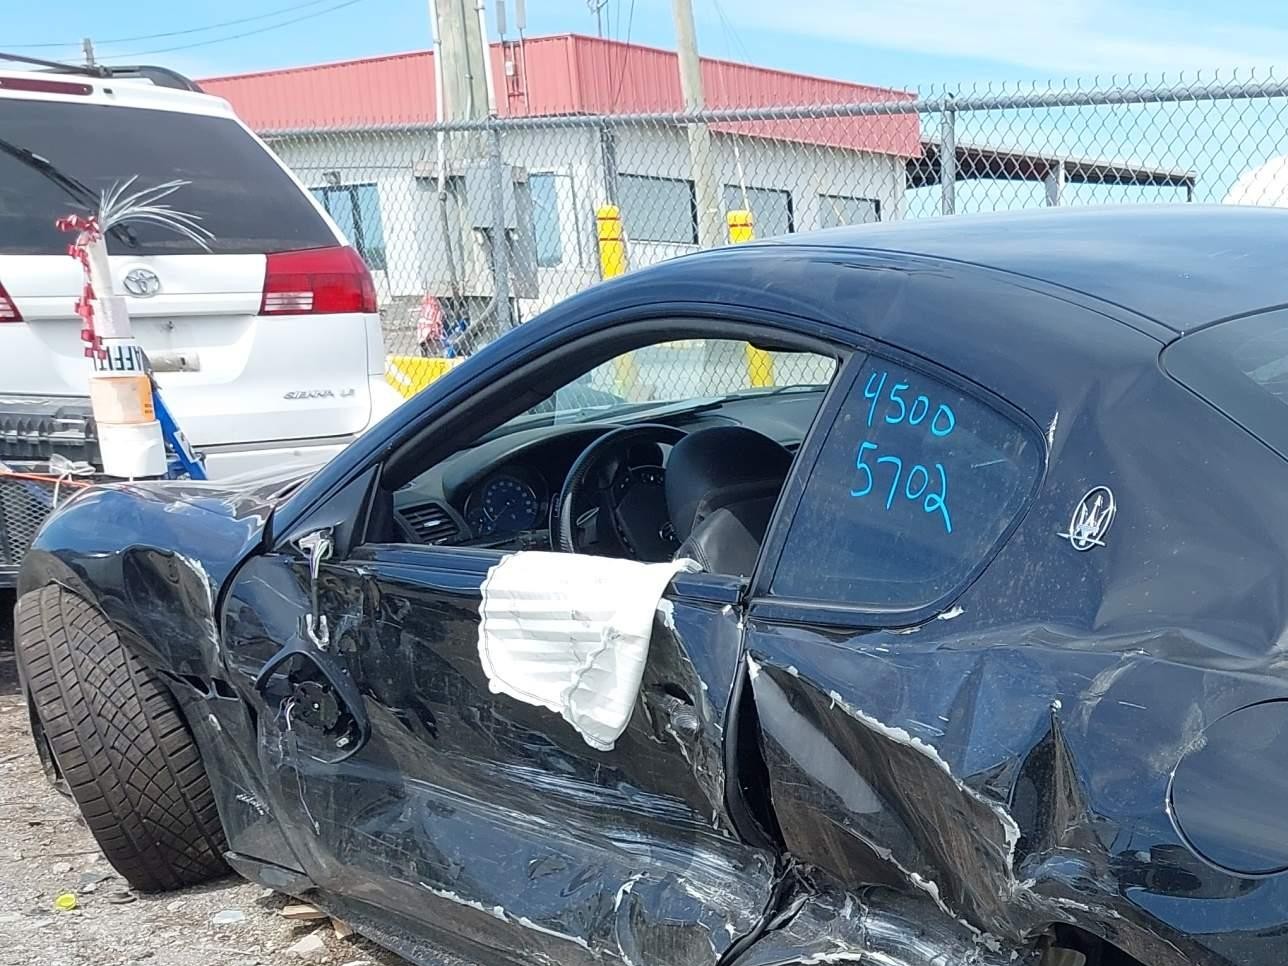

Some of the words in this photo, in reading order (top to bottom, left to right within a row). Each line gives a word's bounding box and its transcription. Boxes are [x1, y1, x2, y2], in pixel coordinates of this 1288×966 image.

[283, 389, 335, 400] SIENNA
[864, 372, 956, 437] 4500
[850, 440, 952, 533] 5702
